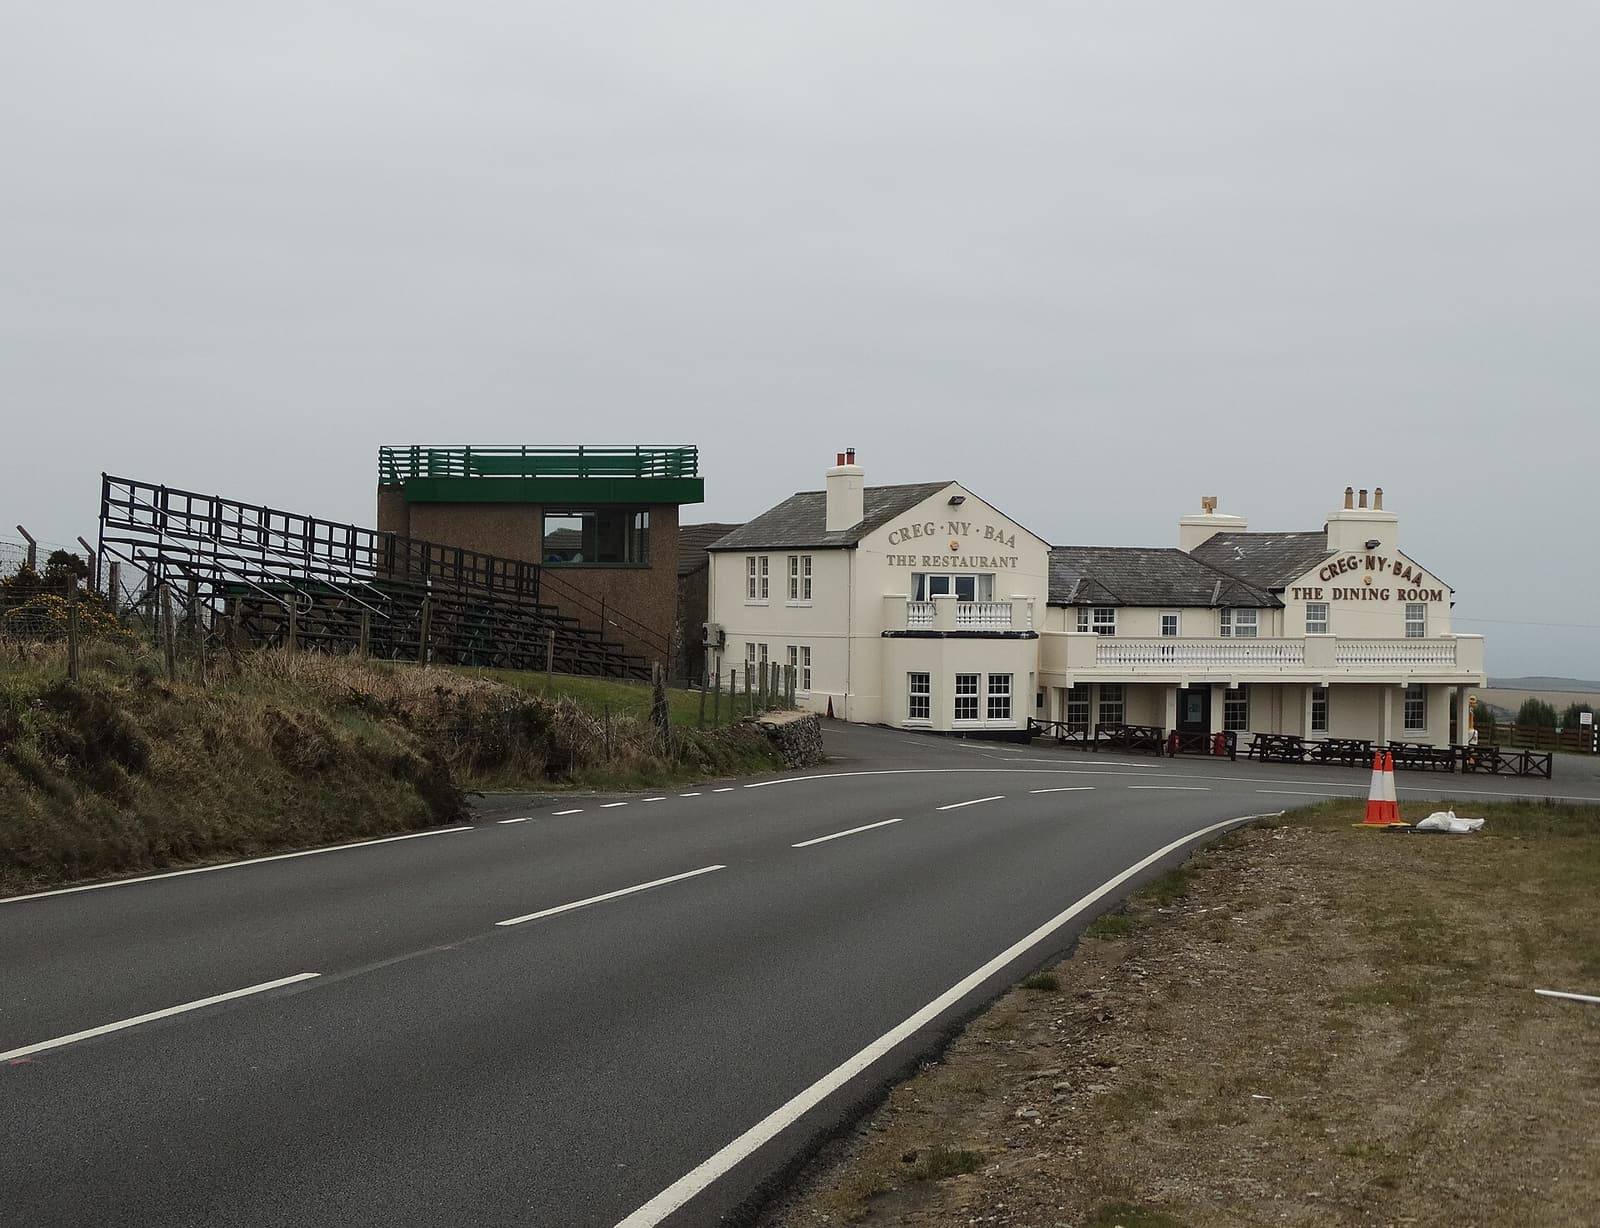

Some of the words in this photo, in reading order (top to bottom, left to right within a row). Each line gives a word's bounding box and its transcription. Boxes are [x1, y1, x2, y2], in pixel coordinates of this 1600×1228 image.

[887, 554, 917, 566] THE
[922, 555, 1018, 568] RESTAURANT
[1292, 588, 1323, 600] THE
[1332, 588, 1390, 601] DINING
[1397, 589, 1443, 602] ROOM
